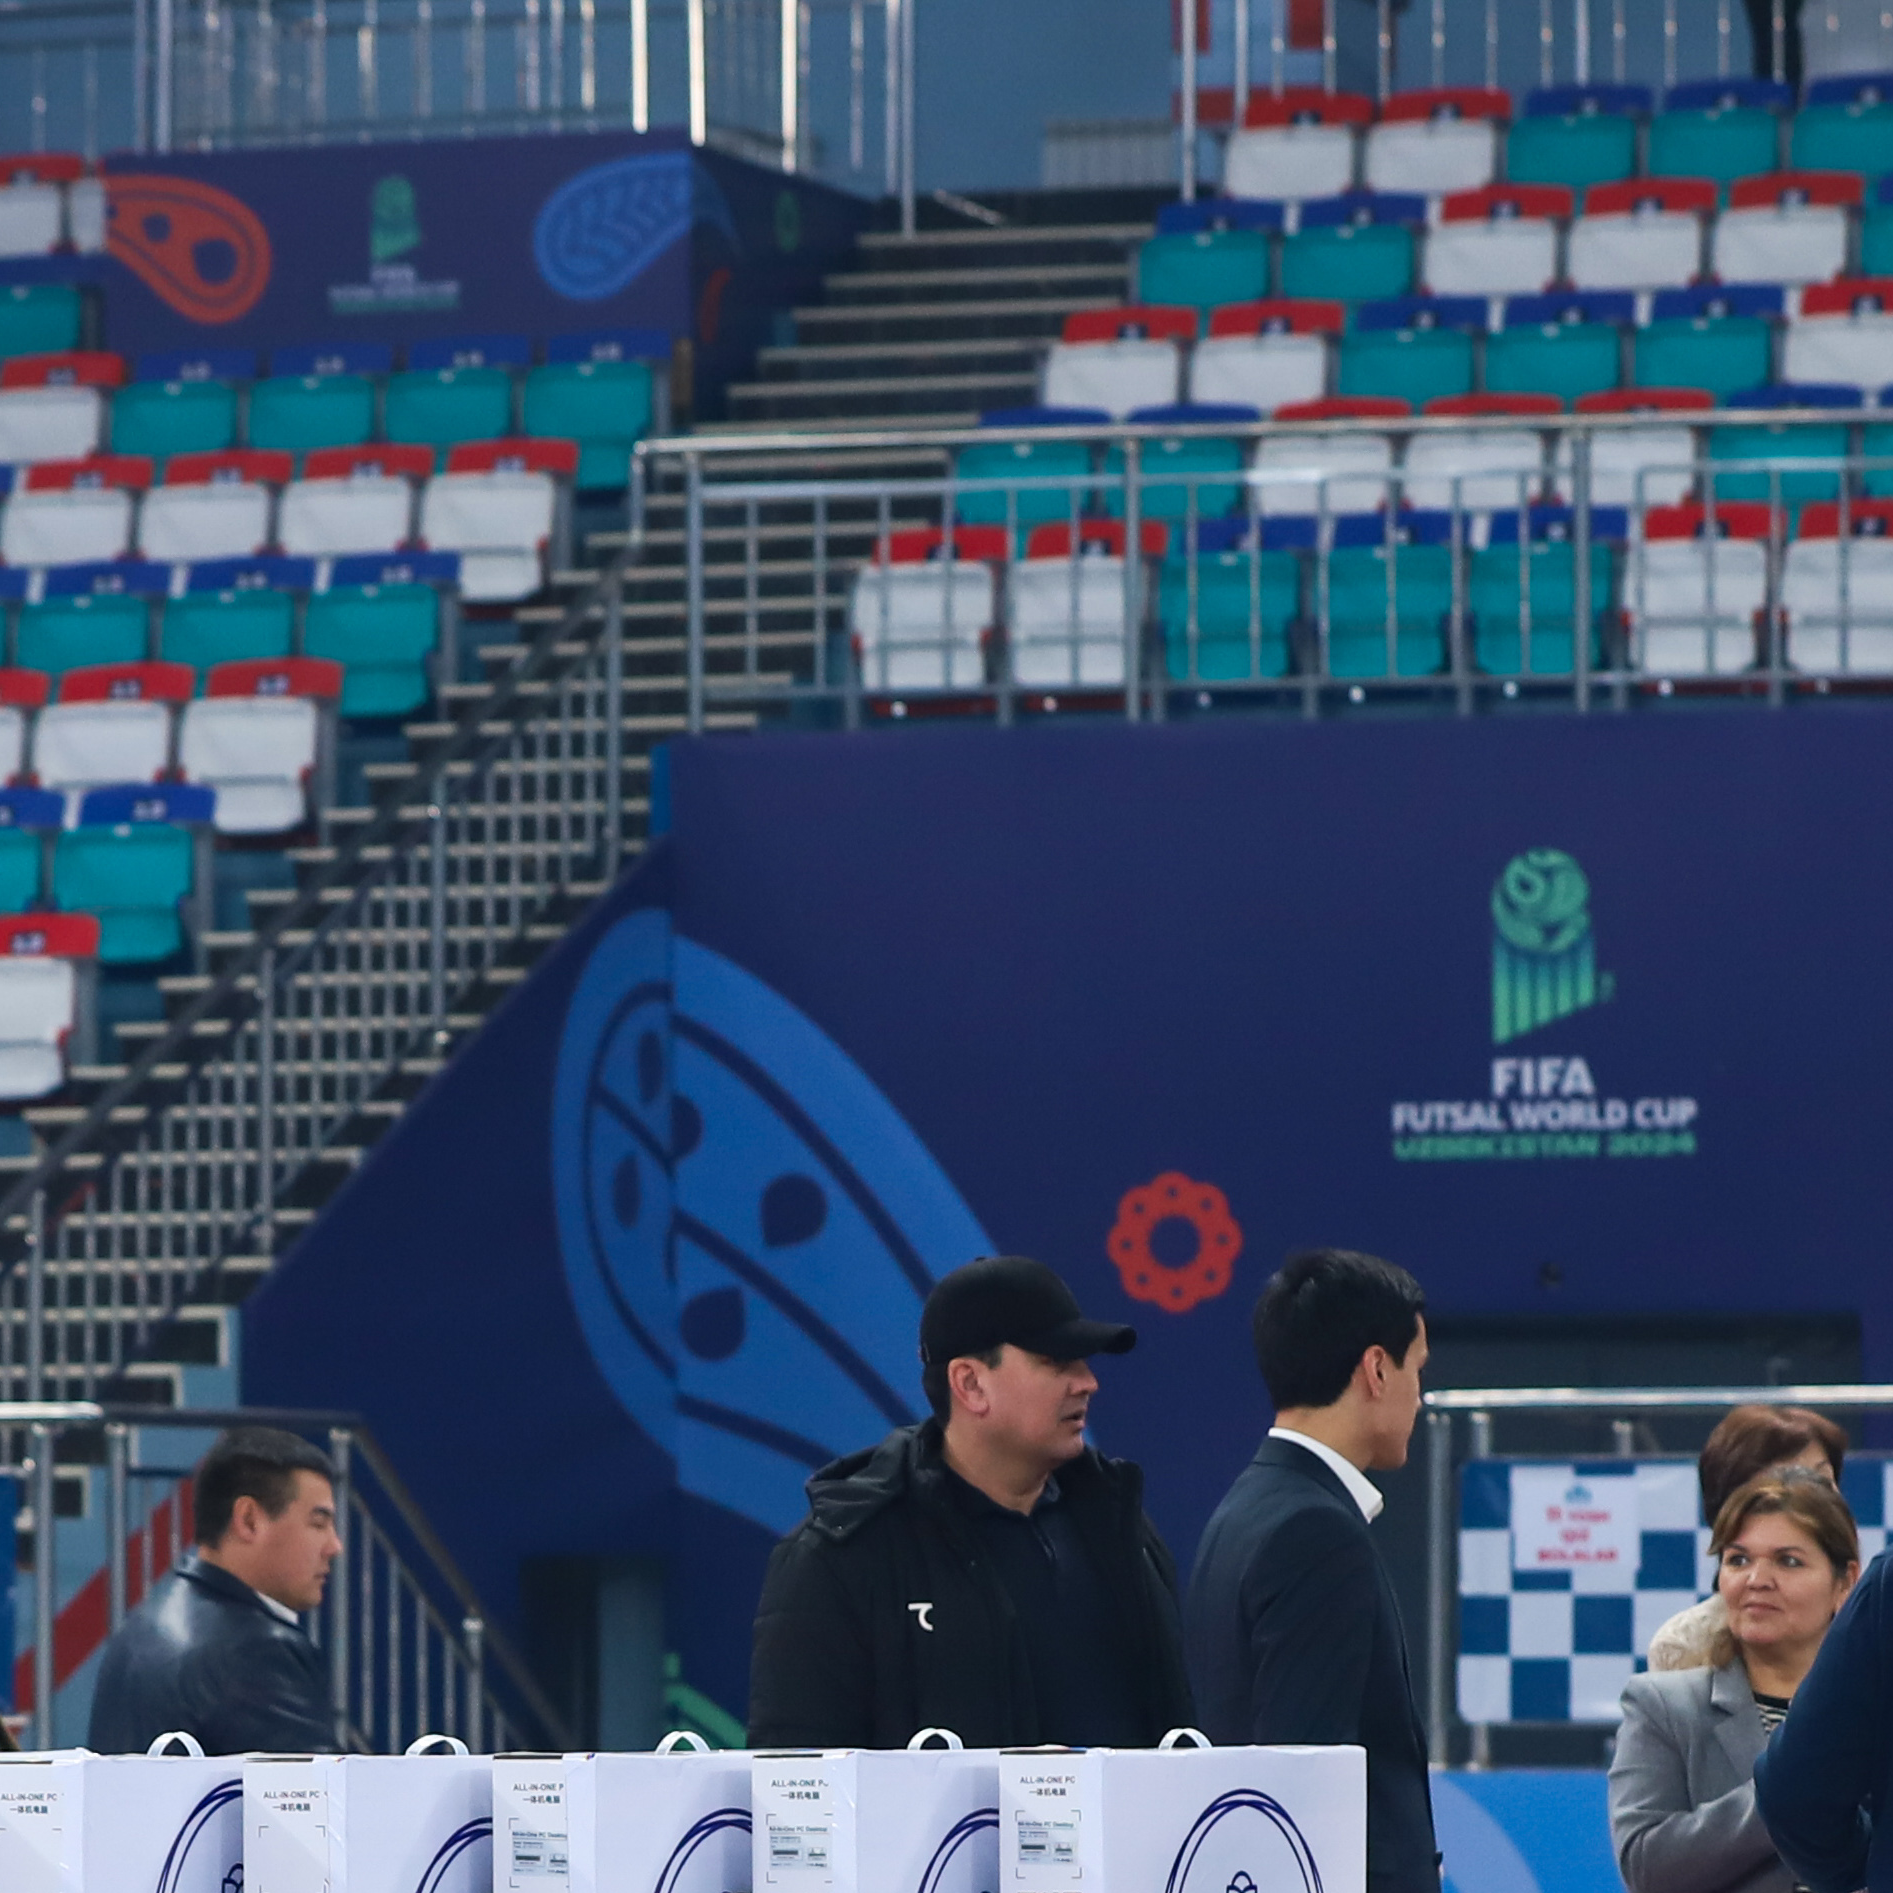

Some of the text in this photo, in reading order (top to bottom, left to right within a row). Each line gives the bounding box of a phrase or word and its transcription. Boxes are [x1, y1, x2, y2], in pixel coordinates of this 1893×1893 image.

[1491, 1058, 1594, 1096] FIFA
[1393, 1099, 1697, 1131] FUTSAL WORLD CUP
